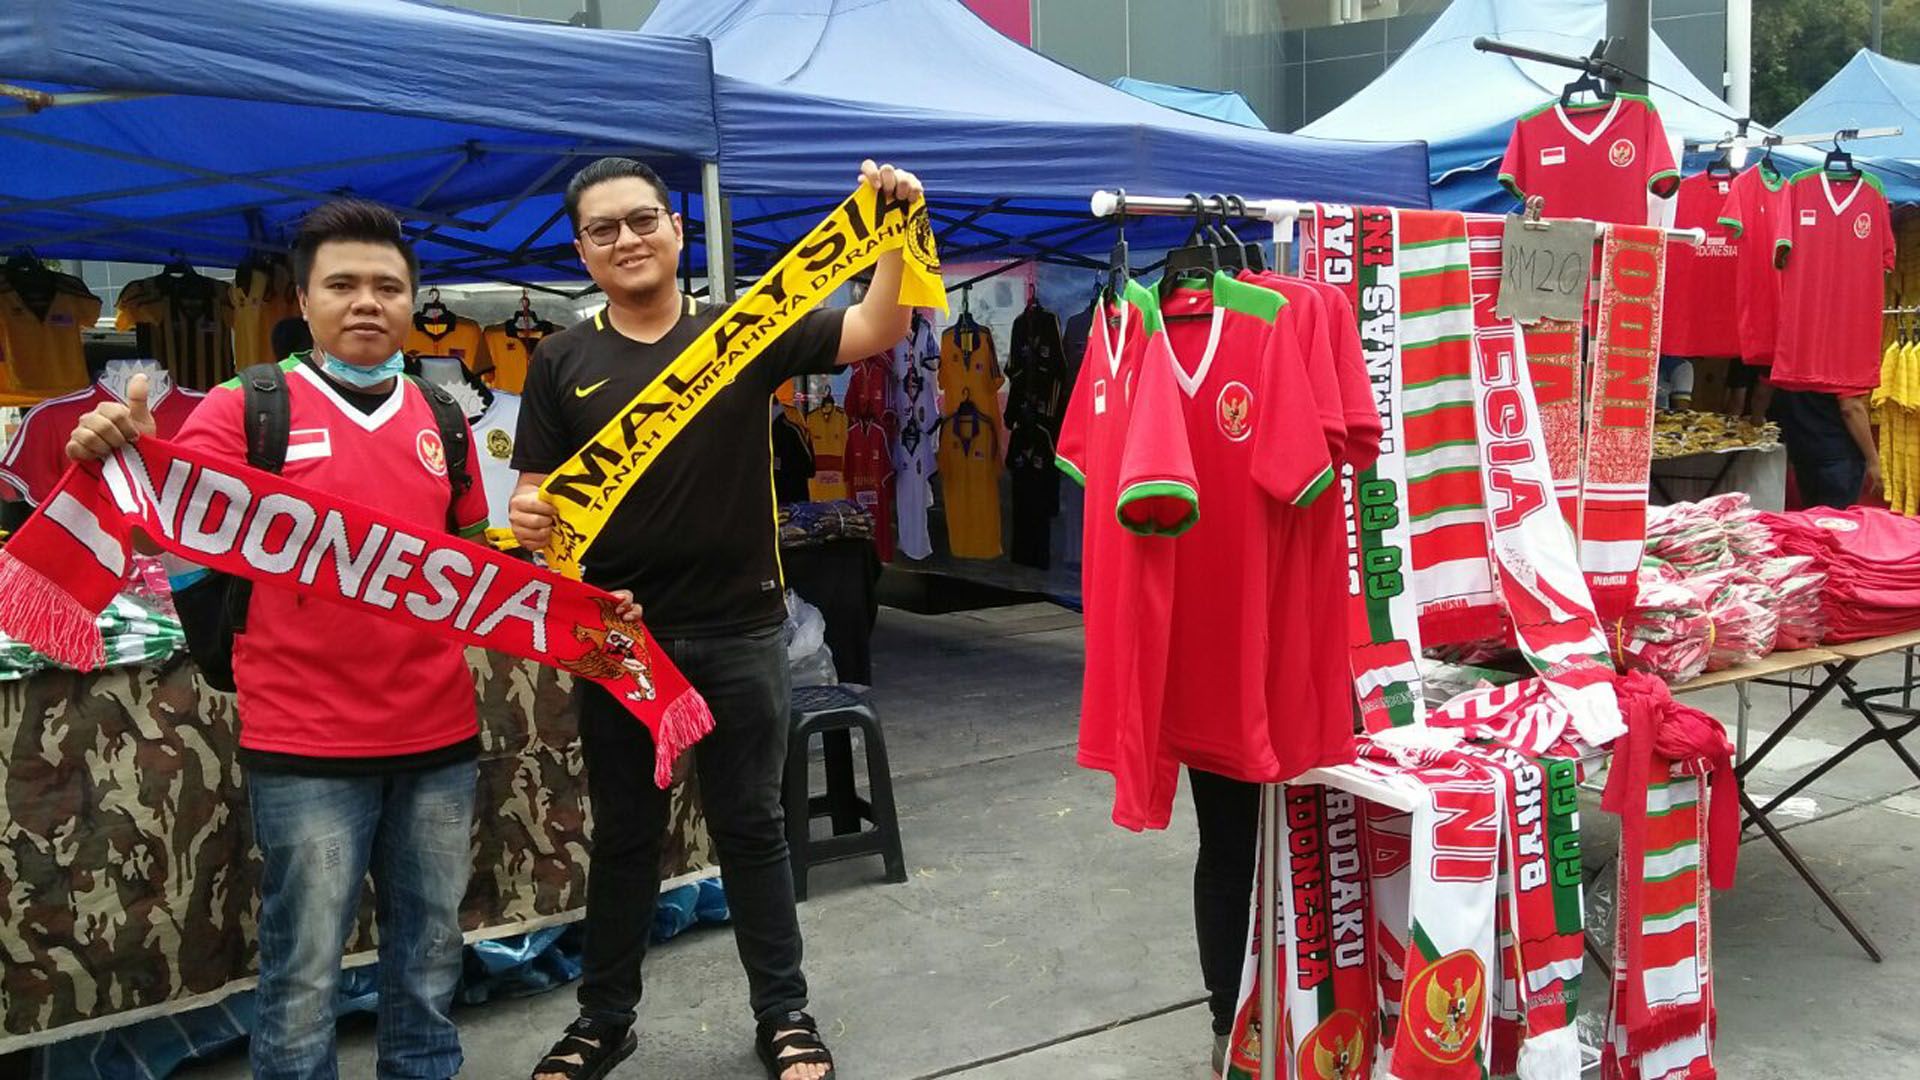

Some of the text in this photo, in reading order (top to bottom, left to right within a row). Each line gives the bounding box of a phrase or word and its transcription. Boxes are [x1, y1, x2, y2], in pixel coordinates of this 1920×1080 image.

[547, 187, 911, 508] MALAYSIA
[1509, 244, 1582, 295] RM20
[590, 431, 660, 512] TANAH
[664, 294, 807, 422] TUMPAHNYA
[102, 442, 553, 653] INDONESIA
[1360, 479, 1404, 600] GO GO
[1324, 786, 1367, 971] RUDAKU
